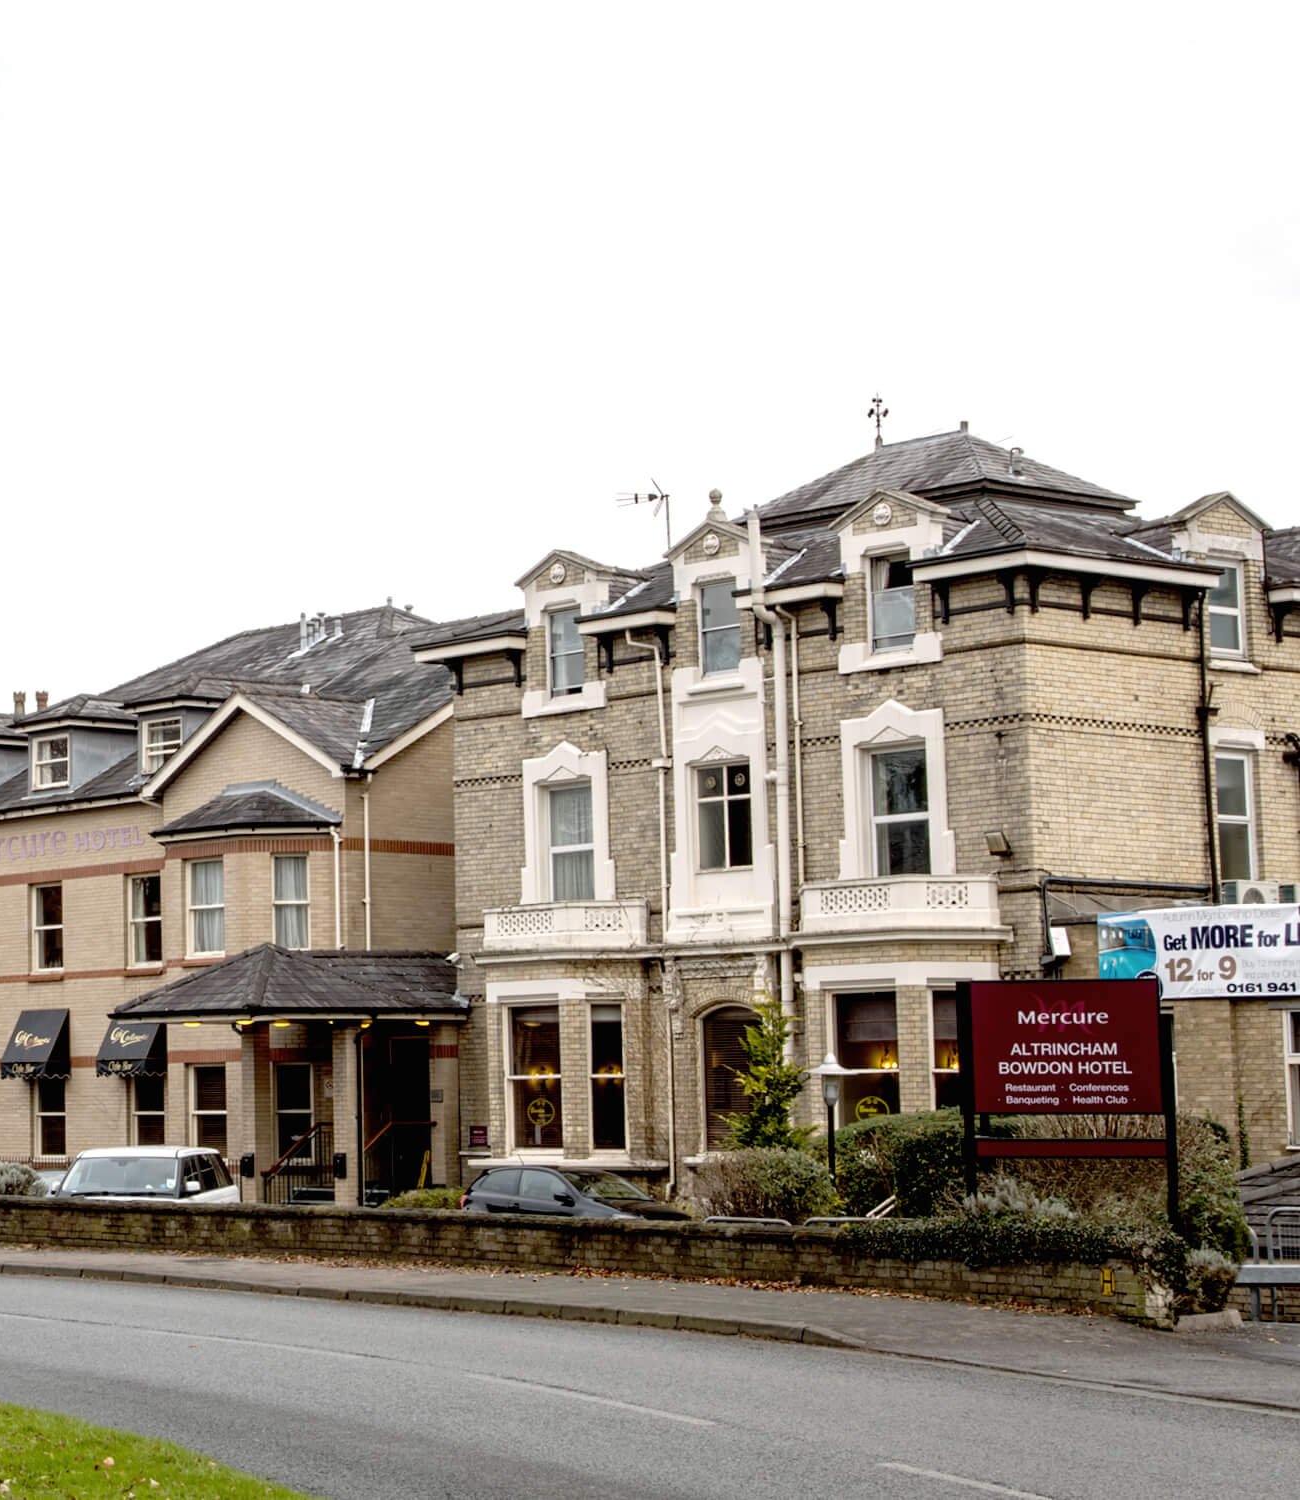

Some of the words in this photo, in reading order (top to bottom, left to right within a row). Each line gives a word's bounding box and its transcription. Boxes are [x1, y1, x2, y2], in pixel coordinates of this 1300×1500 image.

[76, 826, 145, 853] HOTEL
[1163, 934, 1187, 951] Get
[1190, 924, 1253, 950] MORE
[1257, 930, 1280, 948] for
[1165, 957, 1193, 982] 12
[1197, 969, 1215, 981] for
[1218, 955, 1237, 981] 9
[1226, 983, 1262, 993] 0161
[1267, 982, 1297, 993] 941
[1017, 1010, 1109, 1025] Mercure
[1010, 1042, 1118, 1056] ALTRINCHAM
[998, 1061, 1073, 1075] BOWDON
[1078, 1061, 1133, 1075] HOTEL
[1005, 1083, 1056, 1092] Restaurant
[1069, 1083, 1130, 1092] Conferences
[1006, 1096, 1060, 1106] Banqueting
[1072, 1095, 1103, 1104] Health
[1105, 1095, 1128, 1104] Club
